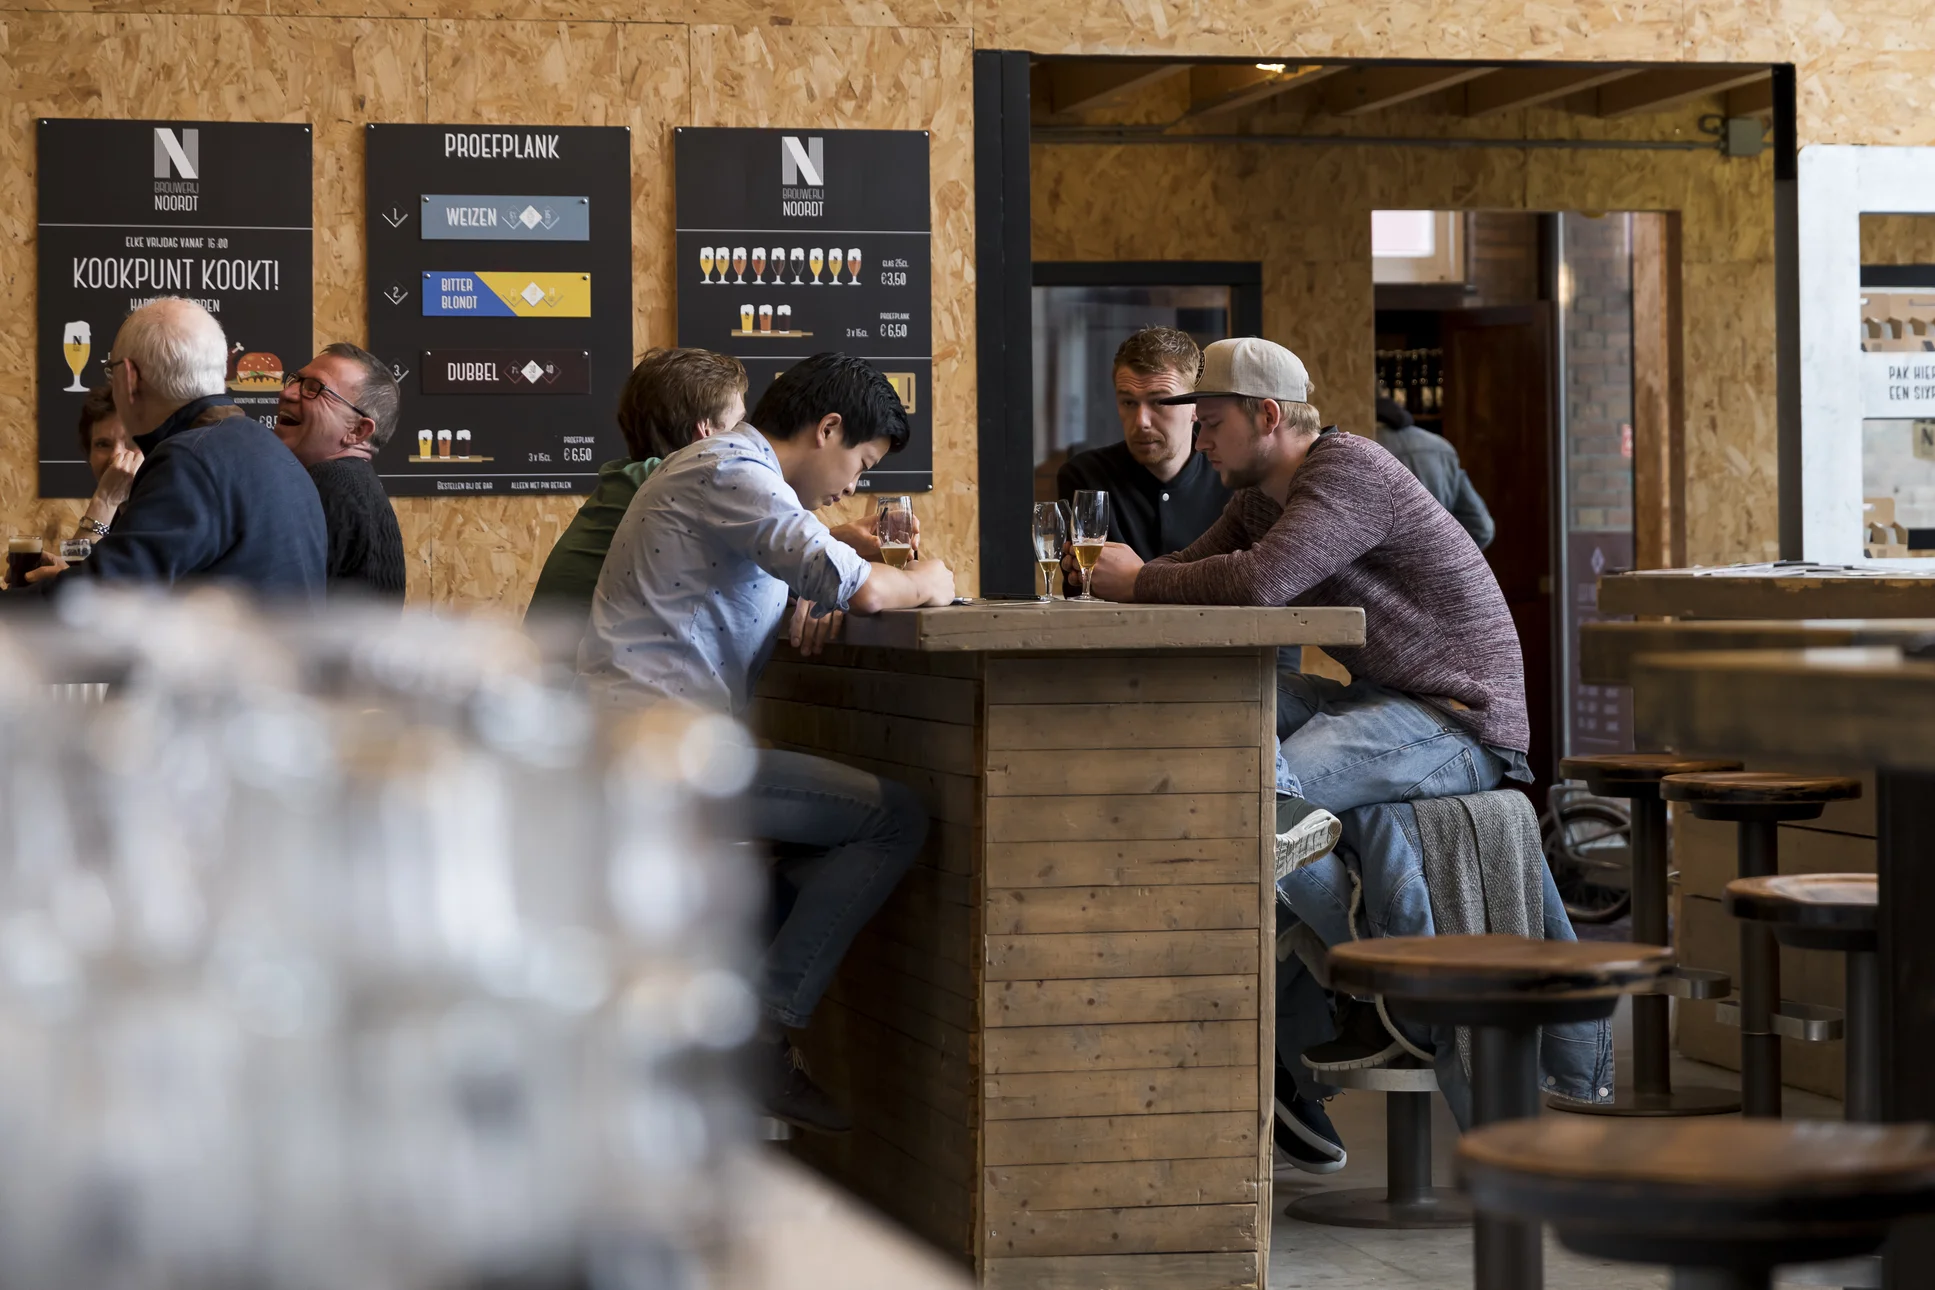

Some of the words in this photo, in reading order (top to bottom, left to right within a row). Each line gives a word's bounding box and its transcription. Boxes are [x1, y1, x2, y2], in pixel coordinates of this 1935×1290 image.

[154, 128, 199, 179] N
[444, 133, 560, 159] PROEFPLANK
[782, 136, 823, 186] N
[154, 182, 199, 194] BROUWERIJ
[782, 188, 824, 200] BROUWERIJ
[154, 195, 199, 211] NOORDT
[783, 201, 824, 217] NOORDT
[446, 207, 497, 226] WEIZEN
[125, 236, 144, 247] ELKE
[146, 237, 178, 248] VRIJDAG
[180, 237, 204, 248] VANAF
[73, 257, 194, 289] KOOKPUNT
[202, 259, 279, 290] KOOKT!
[441, 278, 473, 292] BITTER
[441, 295, 477, 309] BLONDT
[447, 362, 499, 381] DUBBEL
[1889, 365, 1909, 380] PAK
[1889, 385, 1909, 400] EEN
